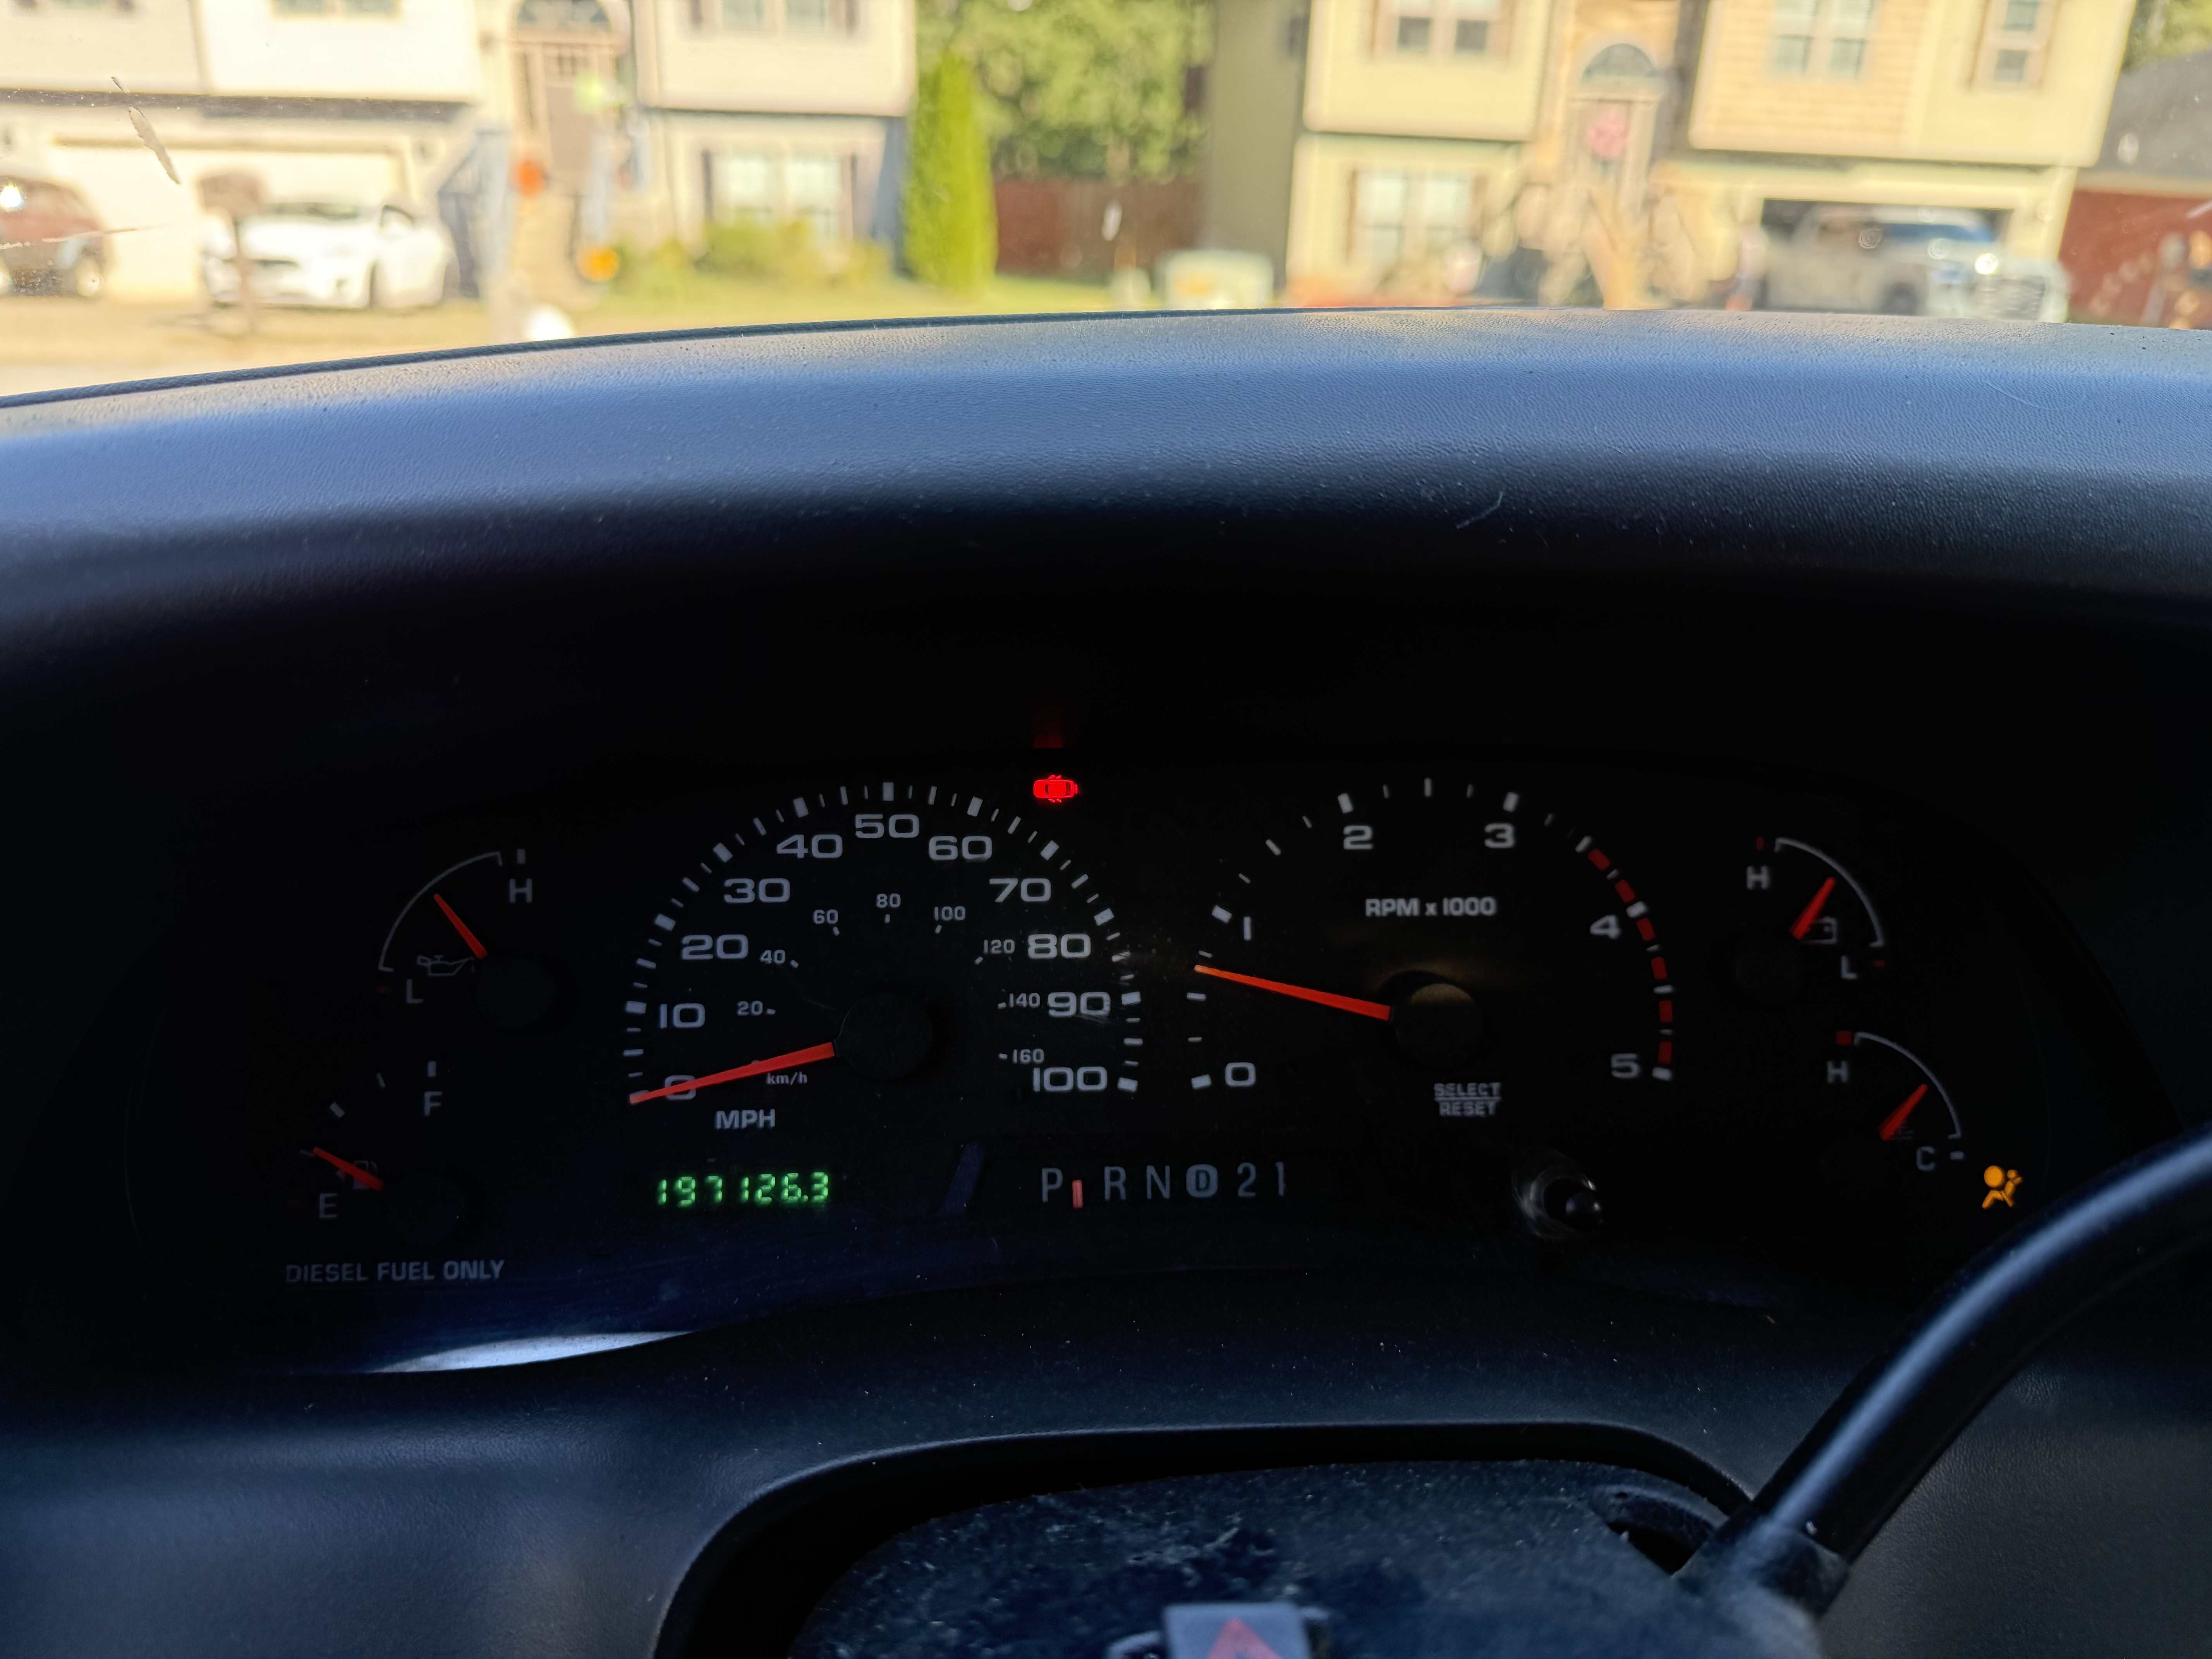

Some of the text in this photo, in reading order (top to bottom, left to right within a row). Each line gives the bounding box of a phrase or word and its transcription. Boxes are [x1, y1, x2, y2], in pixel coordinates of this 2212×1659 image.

[855, 814, 919, 838] 50
[1343, 825, 1373, 850] 2
[1485, 823, 1515, 848] 3
[776, 834, 843, 859] 40
[929, 836, 992, 860] 60
[989, 878, 1051, 902] 70
[1747, 866, 1770, 890] H
[509, 878, 532, 903] H
[724, 878, 790, 903] 30
[876, 893, 901, 908] 80
[812, 910, 838, 924] 60
[934, 906, 965, 921] 100
[1365, 896, 1496, 916] RPM x 1000
[1243, 917, 1252, 941] 1
[1590, 915, 1621, 939] 4
[682, 934, 748, 960] 20
[760, 950, 785, 965] 40
[983, 939, 1015, 954] 120
[1028, 934, 1091, 959] 80
[1841, 955, 1858, 980] L
[406, 979, 423, 1004] L
[1009, 993, 1040, 1008] 140
[659, 1003, 705, 1029] 10
[737, 1001, 763, 1015] 20
[1047, 991, 1111, 1017] 90
[1013, 1049, 1044, 1064] 160
[1611, 1053, 1641, 1079] 5
[766, 1072, 807, 1085] km/h
[1033, 1066, 1108, 1093] 100
[1225, 1062, 1256, 1087] 0
[1827, 1061, 1849, 1083] H
[664, 1075, 697, 1100] 0
[1434, 1082, 1502, 1098] SELECT
[423, 1091, 442, 1116] F
[1437, 1101, 1499, 1117] RESET
[715, 1109, 775, 1129] MPH
[1916, 1146, 1936, 1171] C
[657, 1172, 829, 1207] 197126.3
[1041, 1168, 1063, 1202] P
[1104, 1166, 1126, 1200] R
[1146, 1165, 1170, 1199] N
[1237, 1163, 1256, 1197] 2
[1276, 1162, 1286, 1196] 1
[319, 1193, 337, 1219] E
[286, 1259, 505, 1283] DIESEL FUEL ONLY
